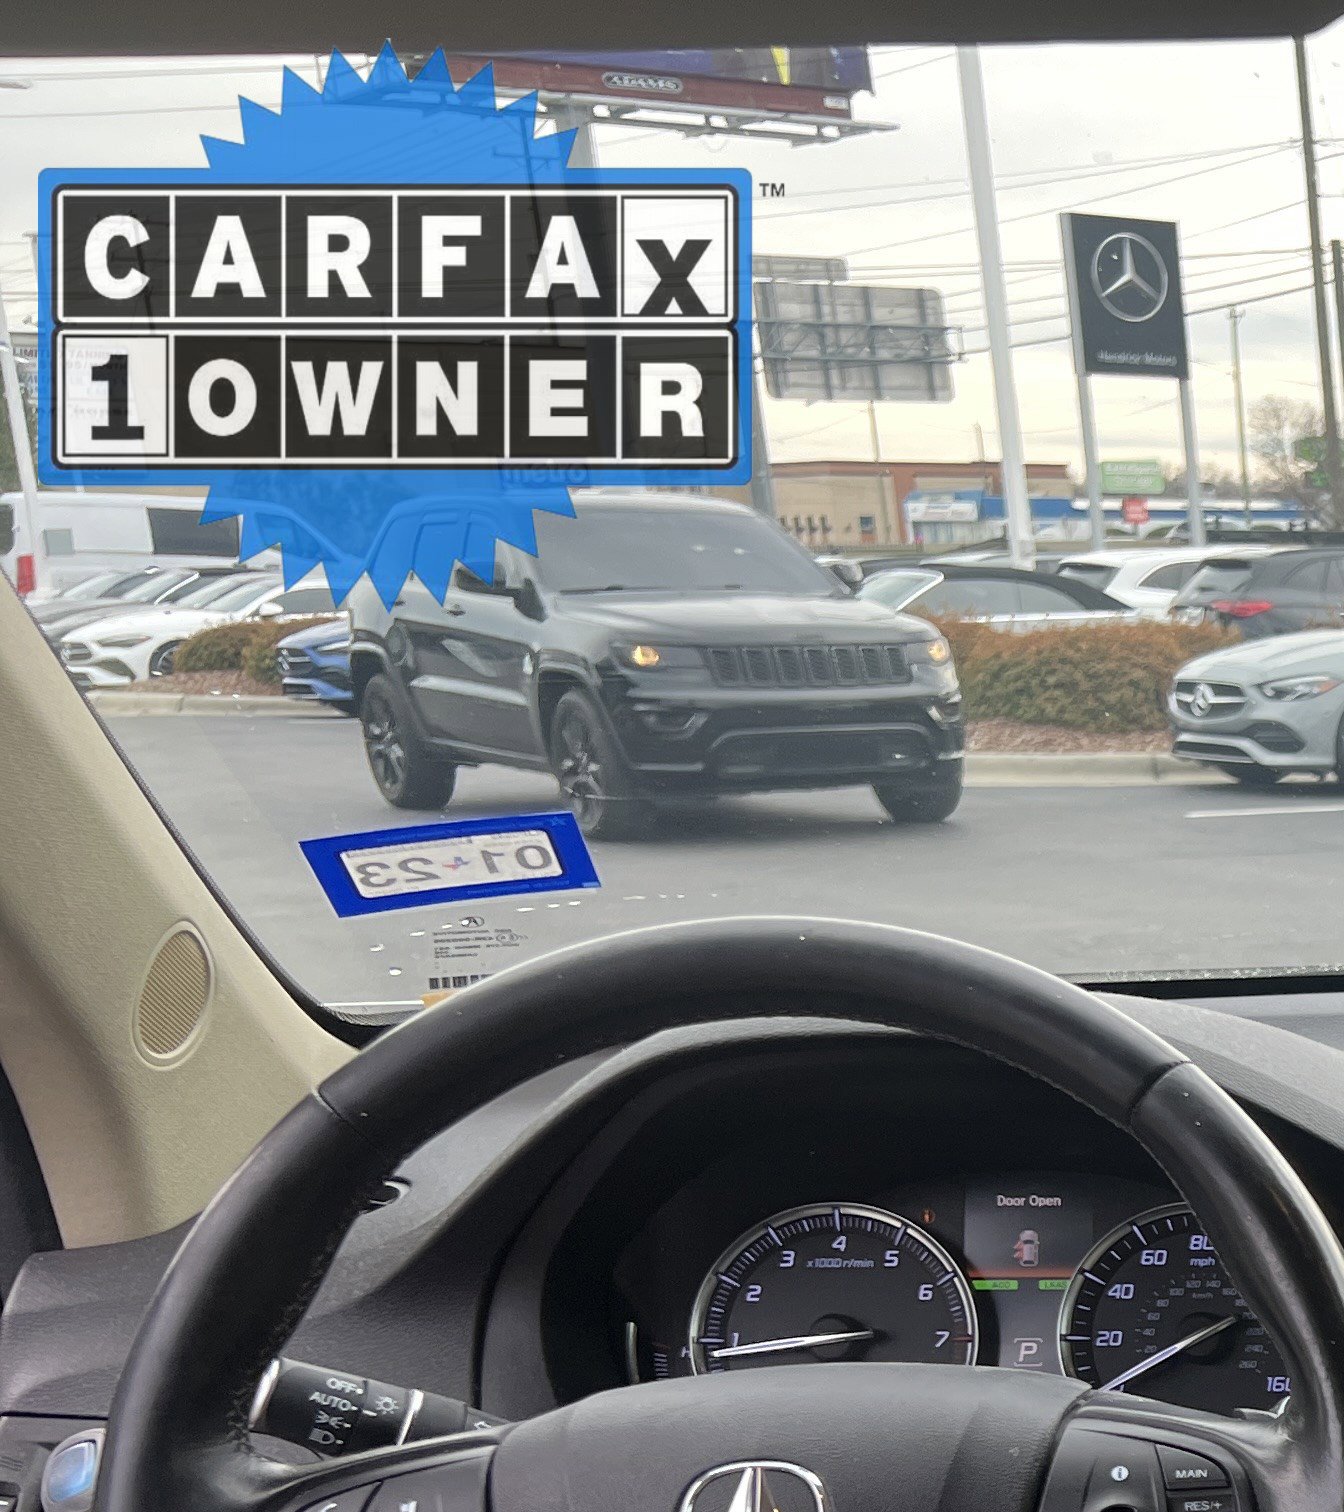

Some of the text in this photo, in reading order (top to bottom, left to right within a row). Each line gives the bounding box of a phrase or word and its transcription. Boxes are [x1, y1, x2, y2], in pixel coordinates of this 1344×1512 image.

[996, 1194, 1063, 1209] Door Open
[830, 1234, 848, 1252] 4
[779, 1250, 796, 1269] 3
[883, 1250, 900, 1268] 5
[1140, 1249, 1168, 1267] 60
[1189, 1257, 1216, 1268] mph
[745, 1284, 763, 1302] 2
[918, 1284, 935, 1301] 6
[1107, 1283, 1135, 1301] 40
[934, 1330, 950, 1348] 7
[1095, 1331, 1124, 1348] 20
[1018, 1341, 1040, 1363] P
[326, 1377, 358, 1393] OFF
[309, 1391, 353, 1412] AUTO
[1175, 1469, 1208, 1480] MAIN
